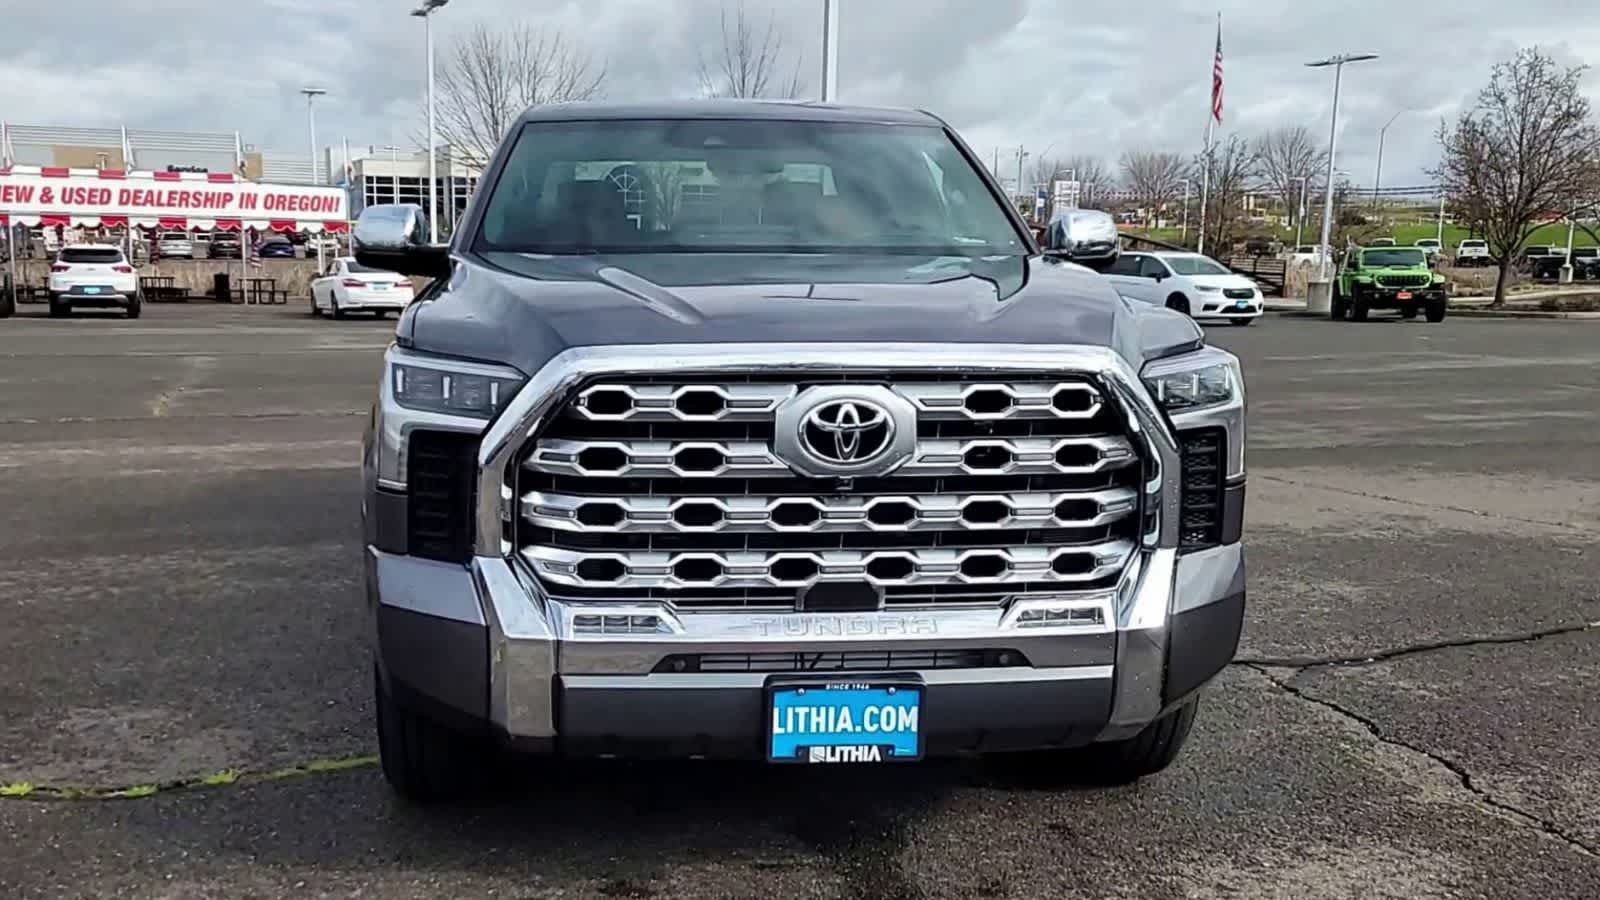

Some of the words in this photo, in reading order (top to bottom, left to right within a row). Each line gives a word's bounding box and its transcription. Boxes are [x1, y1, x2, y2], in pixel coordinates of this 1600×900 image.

[0, 185, 35, 203] EW
[39, 187, 55, 204] &
[61, 187, 112, 205] USED
[118, 189, 234, 209] DEALERSHIP
[238, 192, 258, 209] IN
[263, 194, 340, 212] OREGON!
[751, 615, 938, 636] TUNDRA
[772, 705, 919, 734] LITHIA.COM
[825, 745, 882, 763] LITHIA
